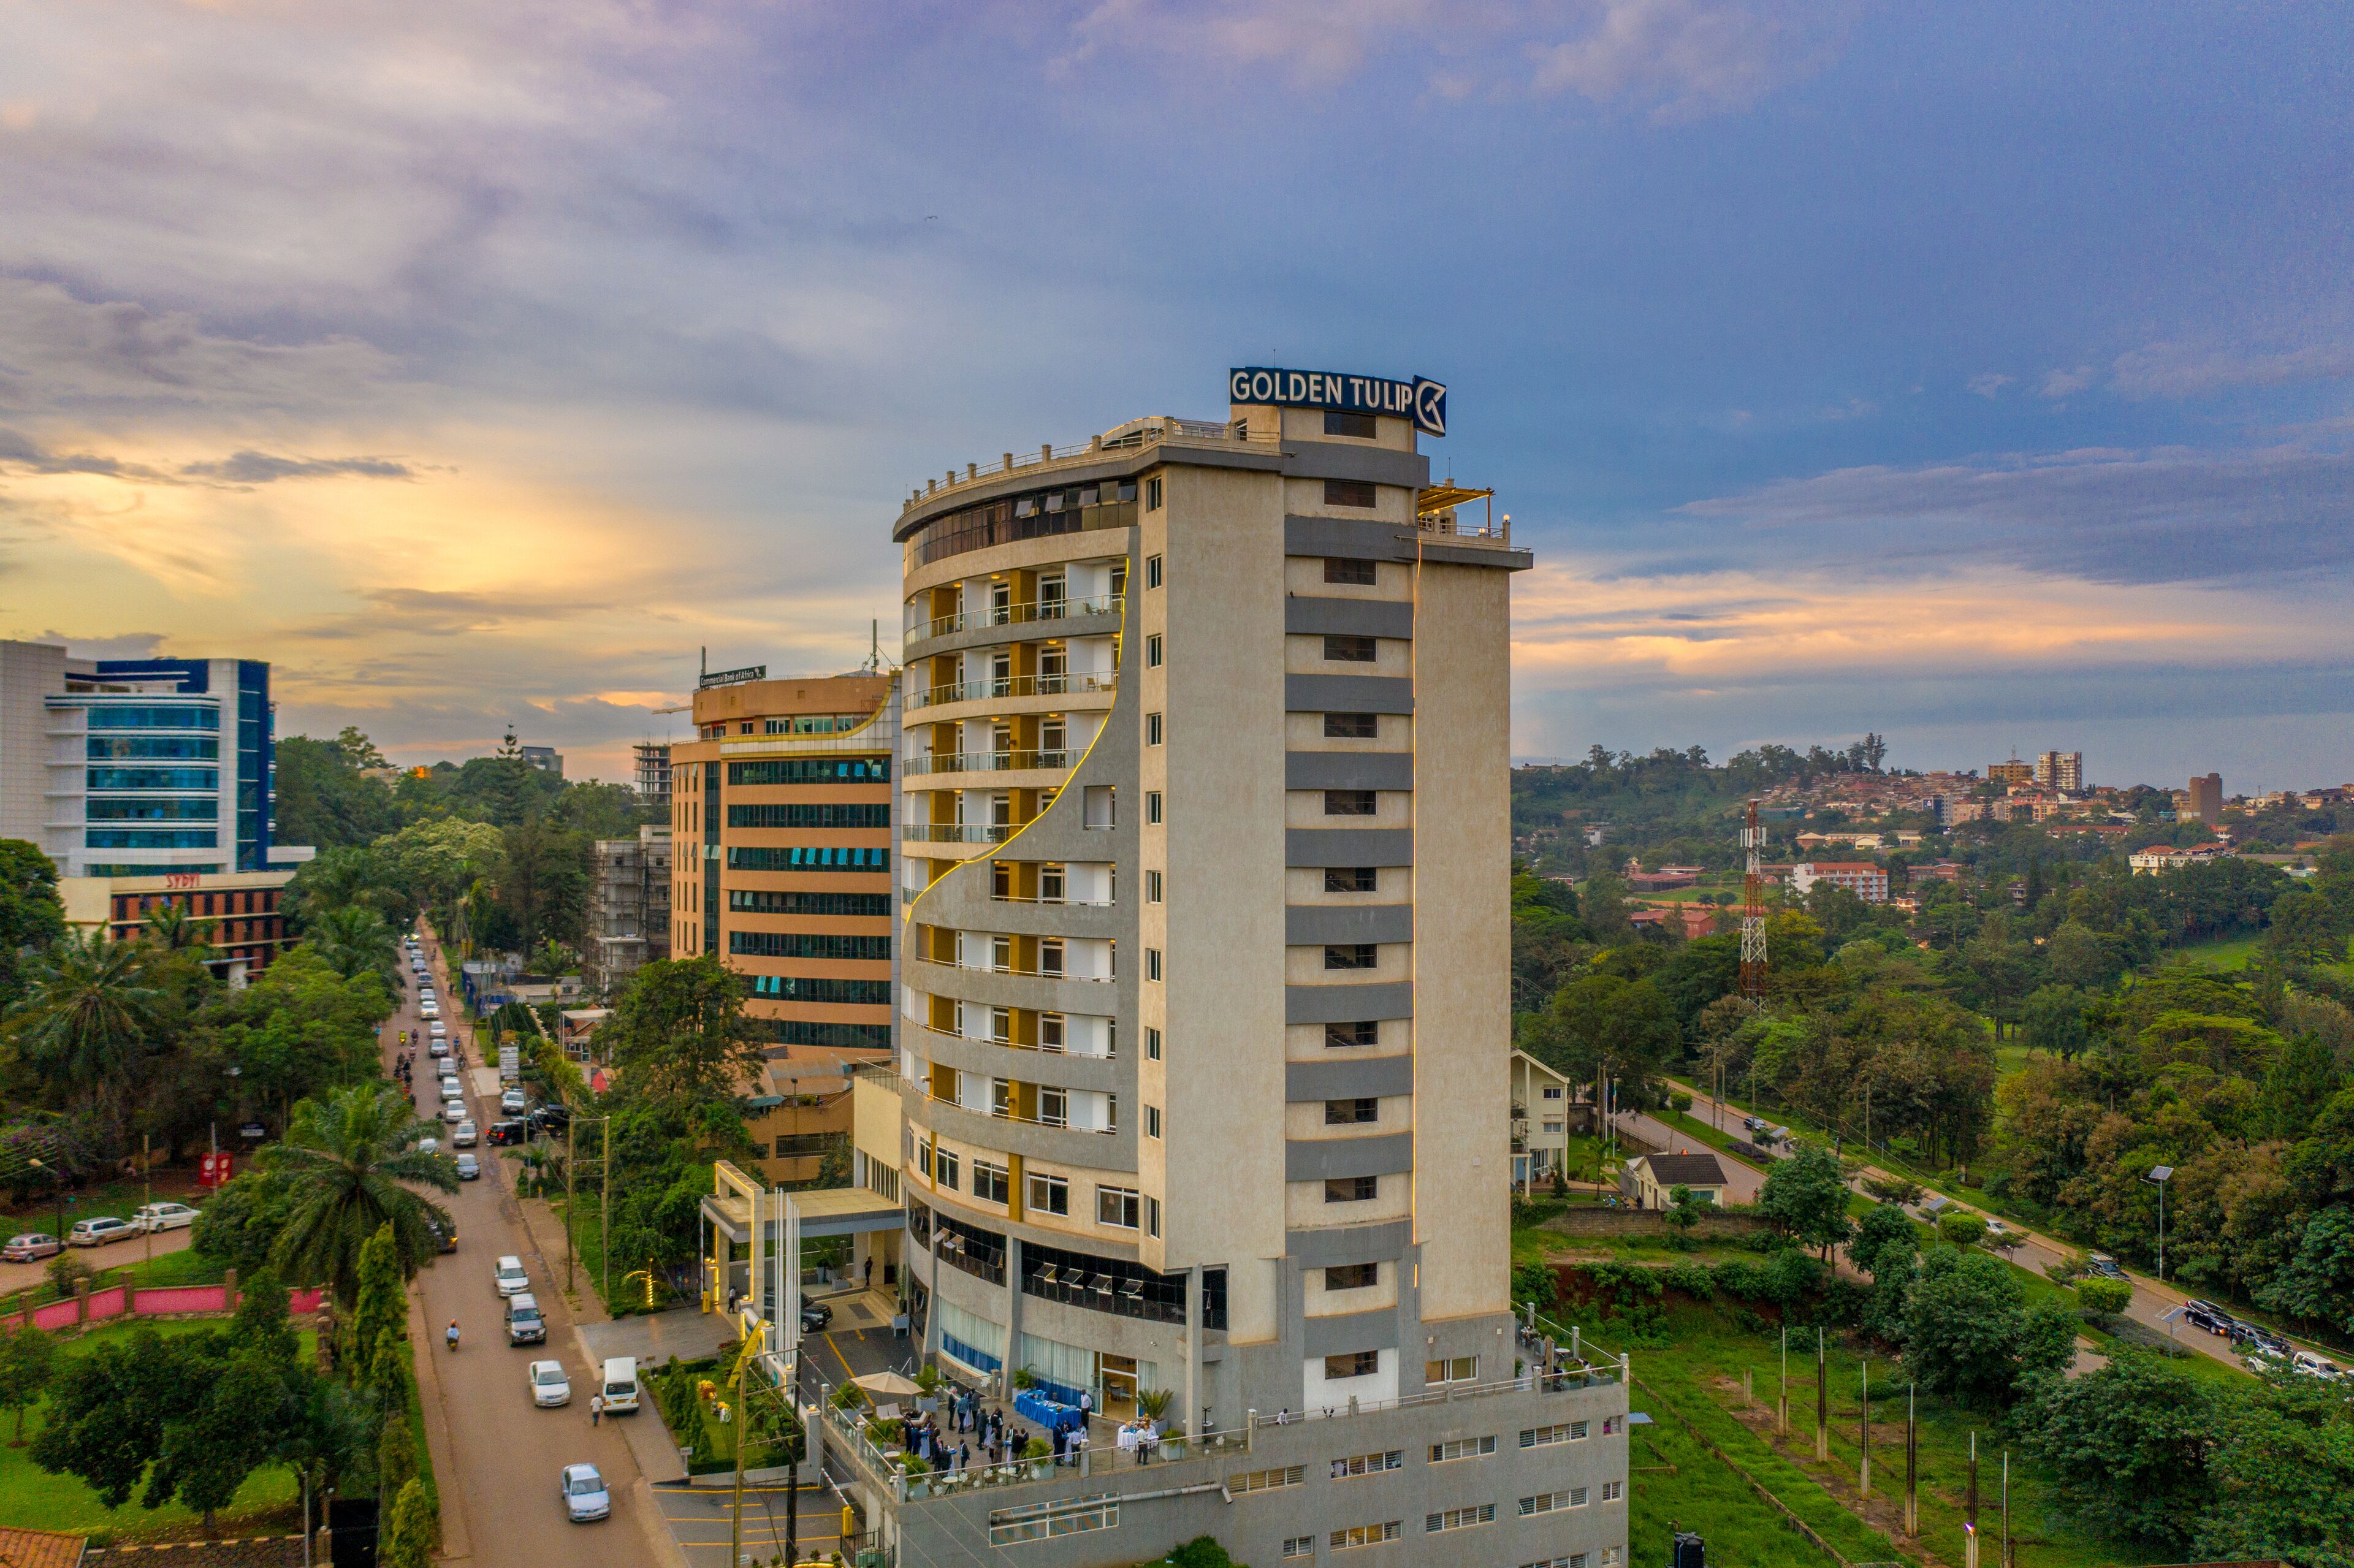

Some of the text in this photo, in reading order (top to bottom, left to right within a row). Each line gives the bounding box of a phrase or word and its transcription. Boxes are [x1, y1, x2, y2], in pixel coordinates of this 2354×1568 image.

[1231, 371, 1413, 413] GOLDEN TULIP
[701, 675, 724, 685] Commercial
[725, 673, 734, 682] Bank
[736, 671, 741, 680] of
[741, 671, 753, 679] Africa
